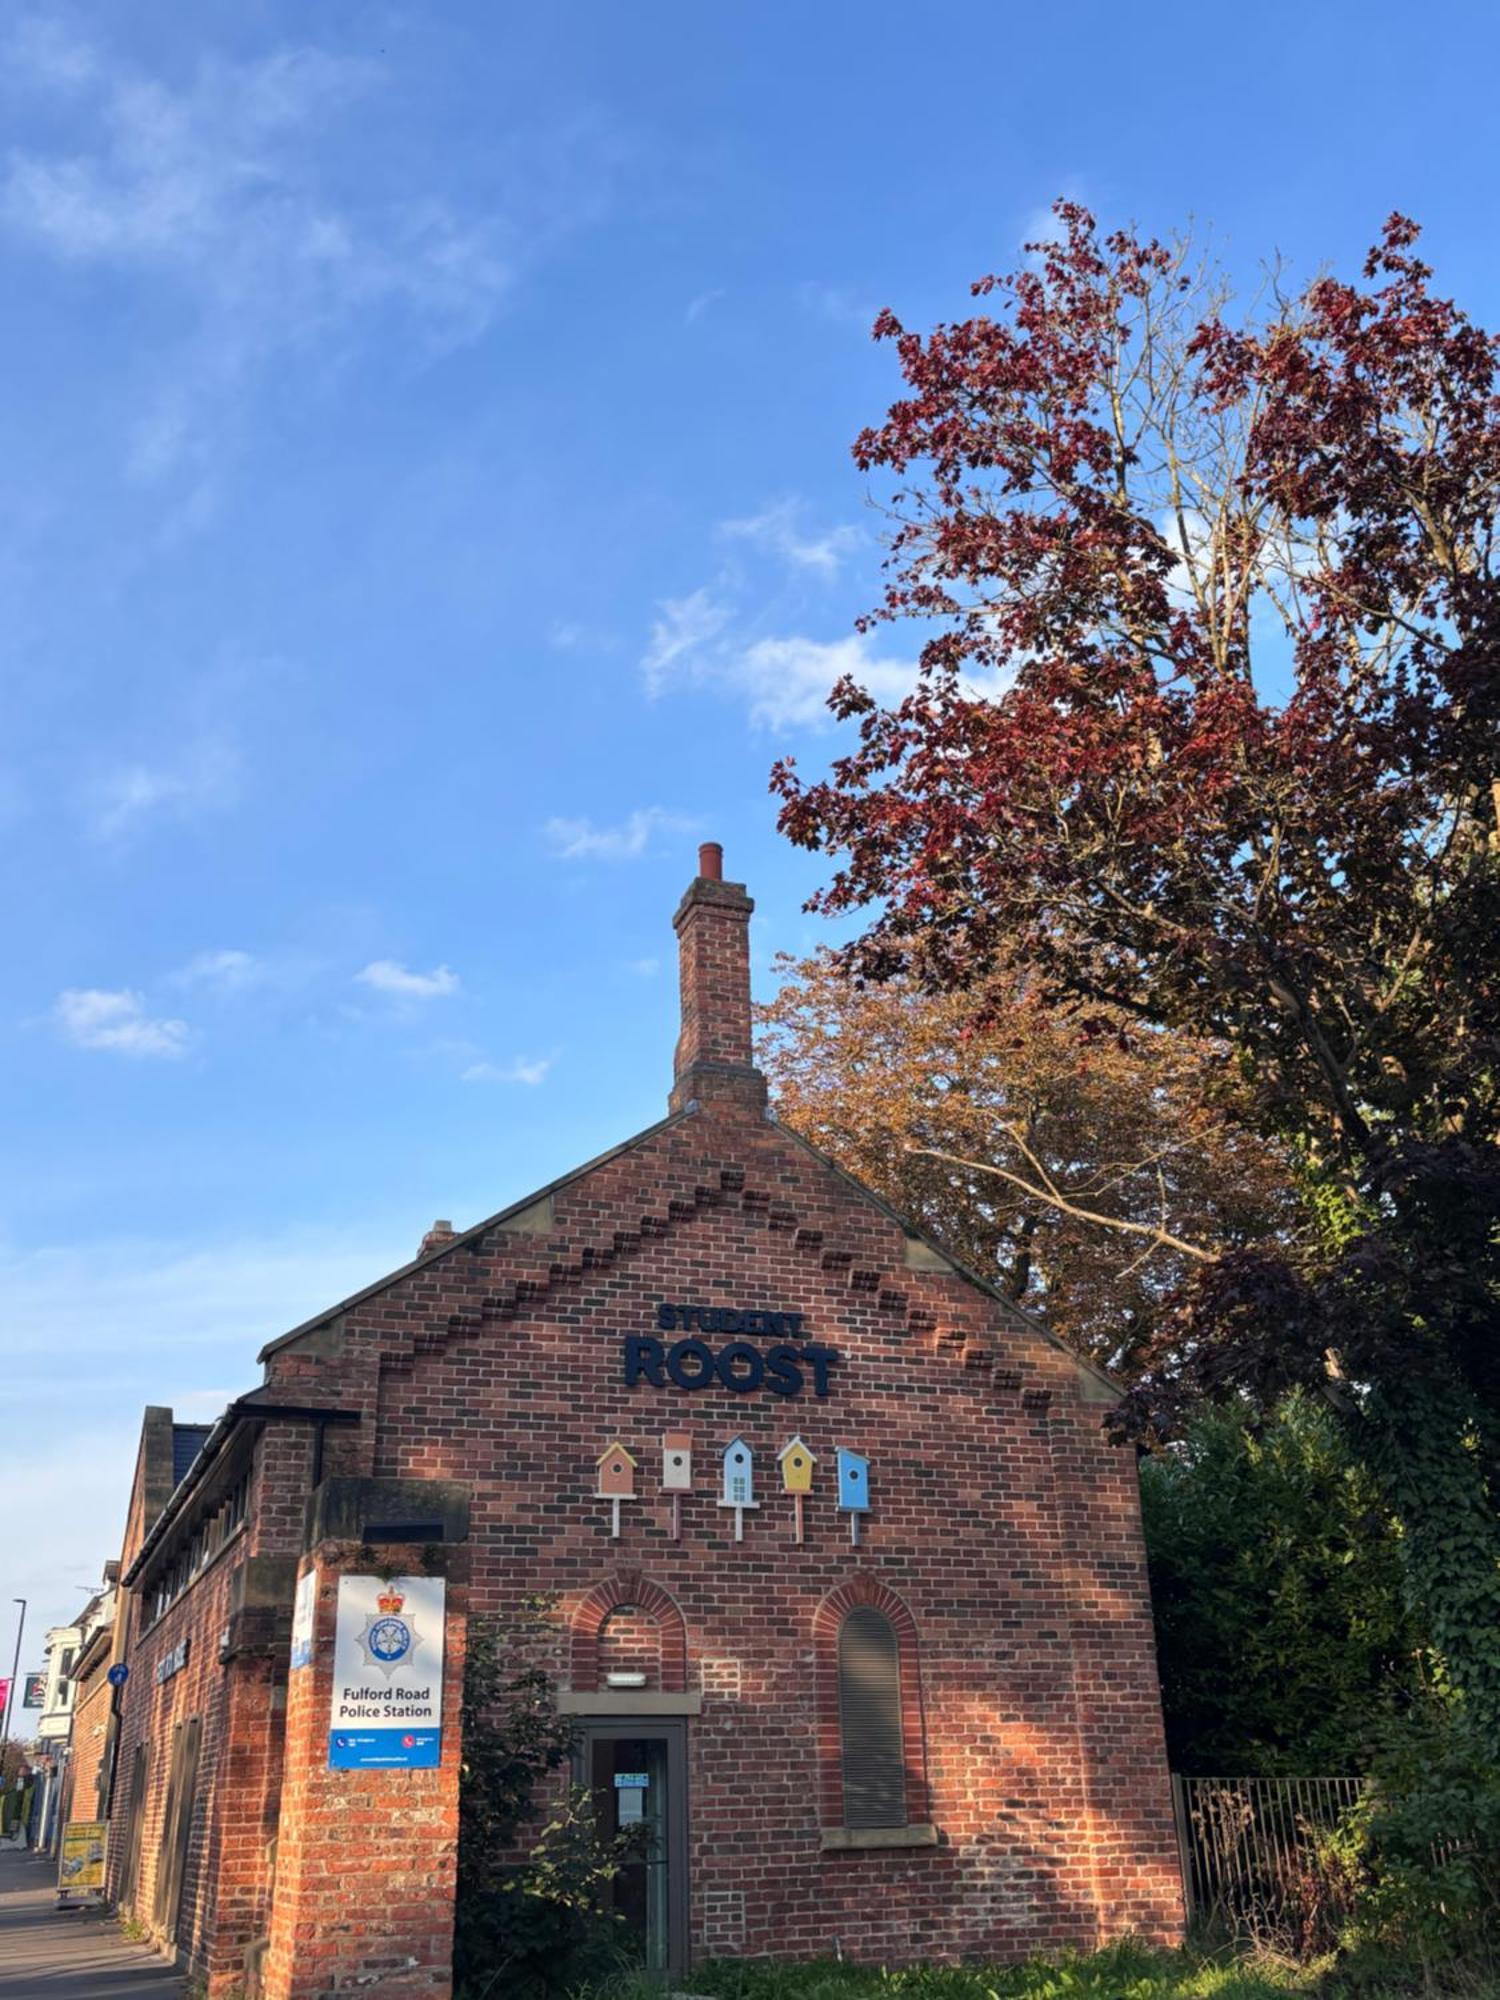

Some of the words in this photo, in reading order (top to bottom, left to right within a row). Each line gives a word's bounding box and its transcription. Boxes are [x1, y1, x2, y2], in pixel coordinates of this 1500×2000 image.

[657, 1303, 806, 1338] STUDENT
[624, 1335, 839, 1397] ROOST
[343, 1687, 393, 1701] Fulford
[396, 1687, 430, 1701] Road
[340, 1704, 381, 1718] Police
[383, 1703, 432, 1717] Station
